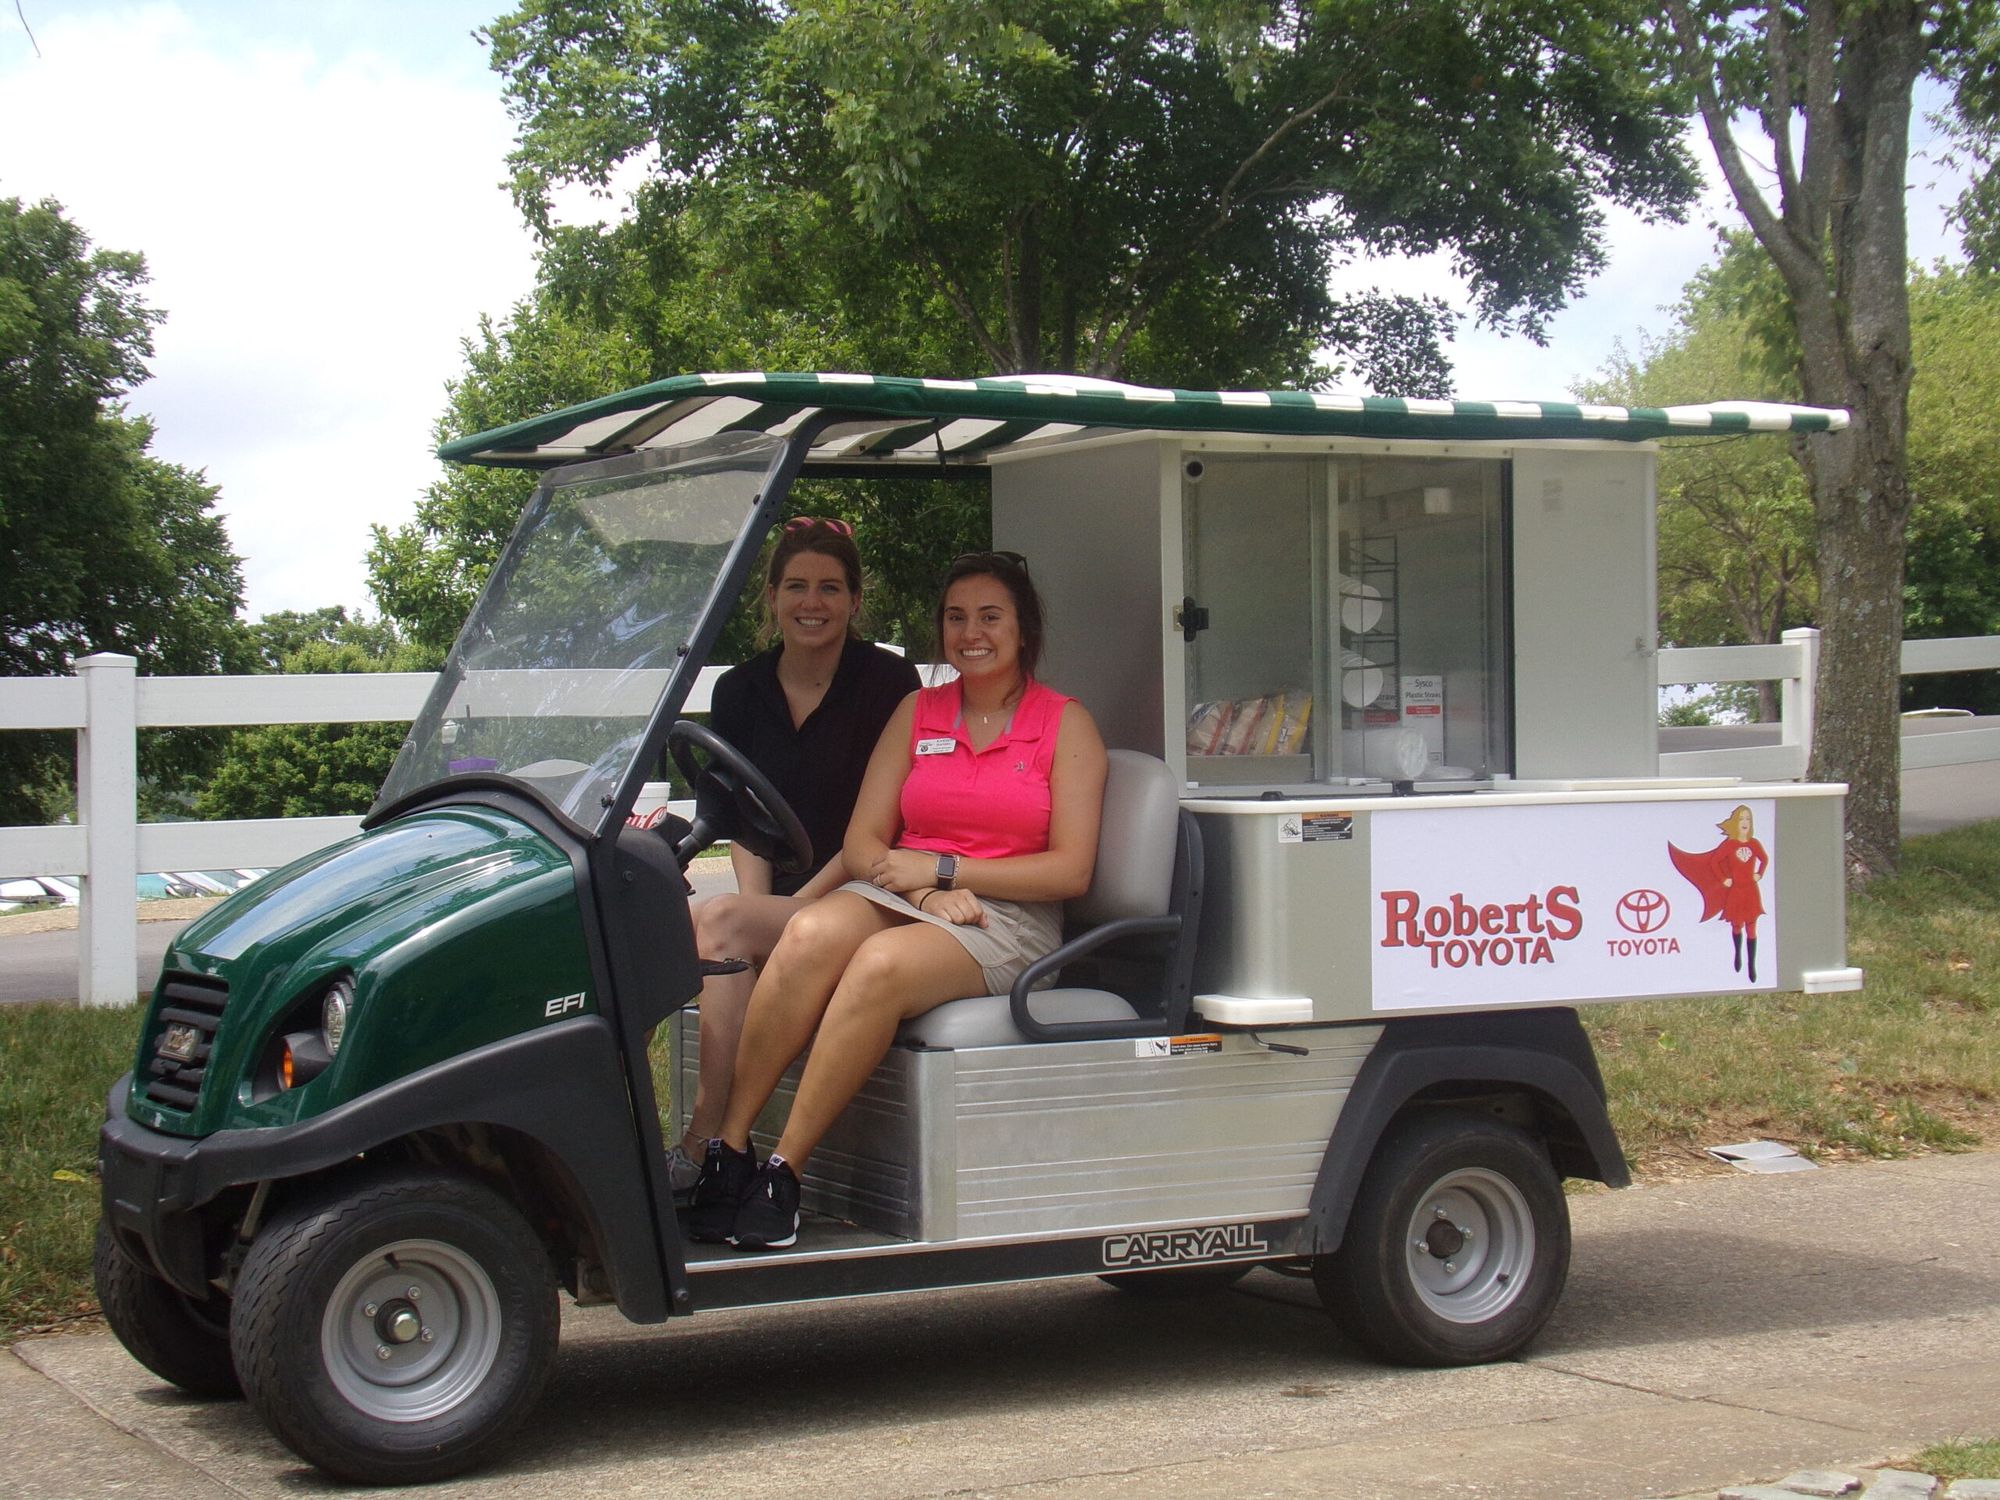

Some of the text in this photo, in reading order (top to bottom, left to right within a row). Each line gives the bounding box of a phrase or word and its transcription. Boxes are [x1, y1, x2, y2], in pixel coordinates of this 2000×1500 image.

[1424, 937, 1555, 968] TOYOTA
[1607, 937, 1681, 957] TOYOTA
[545, 991, 586, 1017] EFI
[1102, 1224, 1268, 1266] CARRYALL
